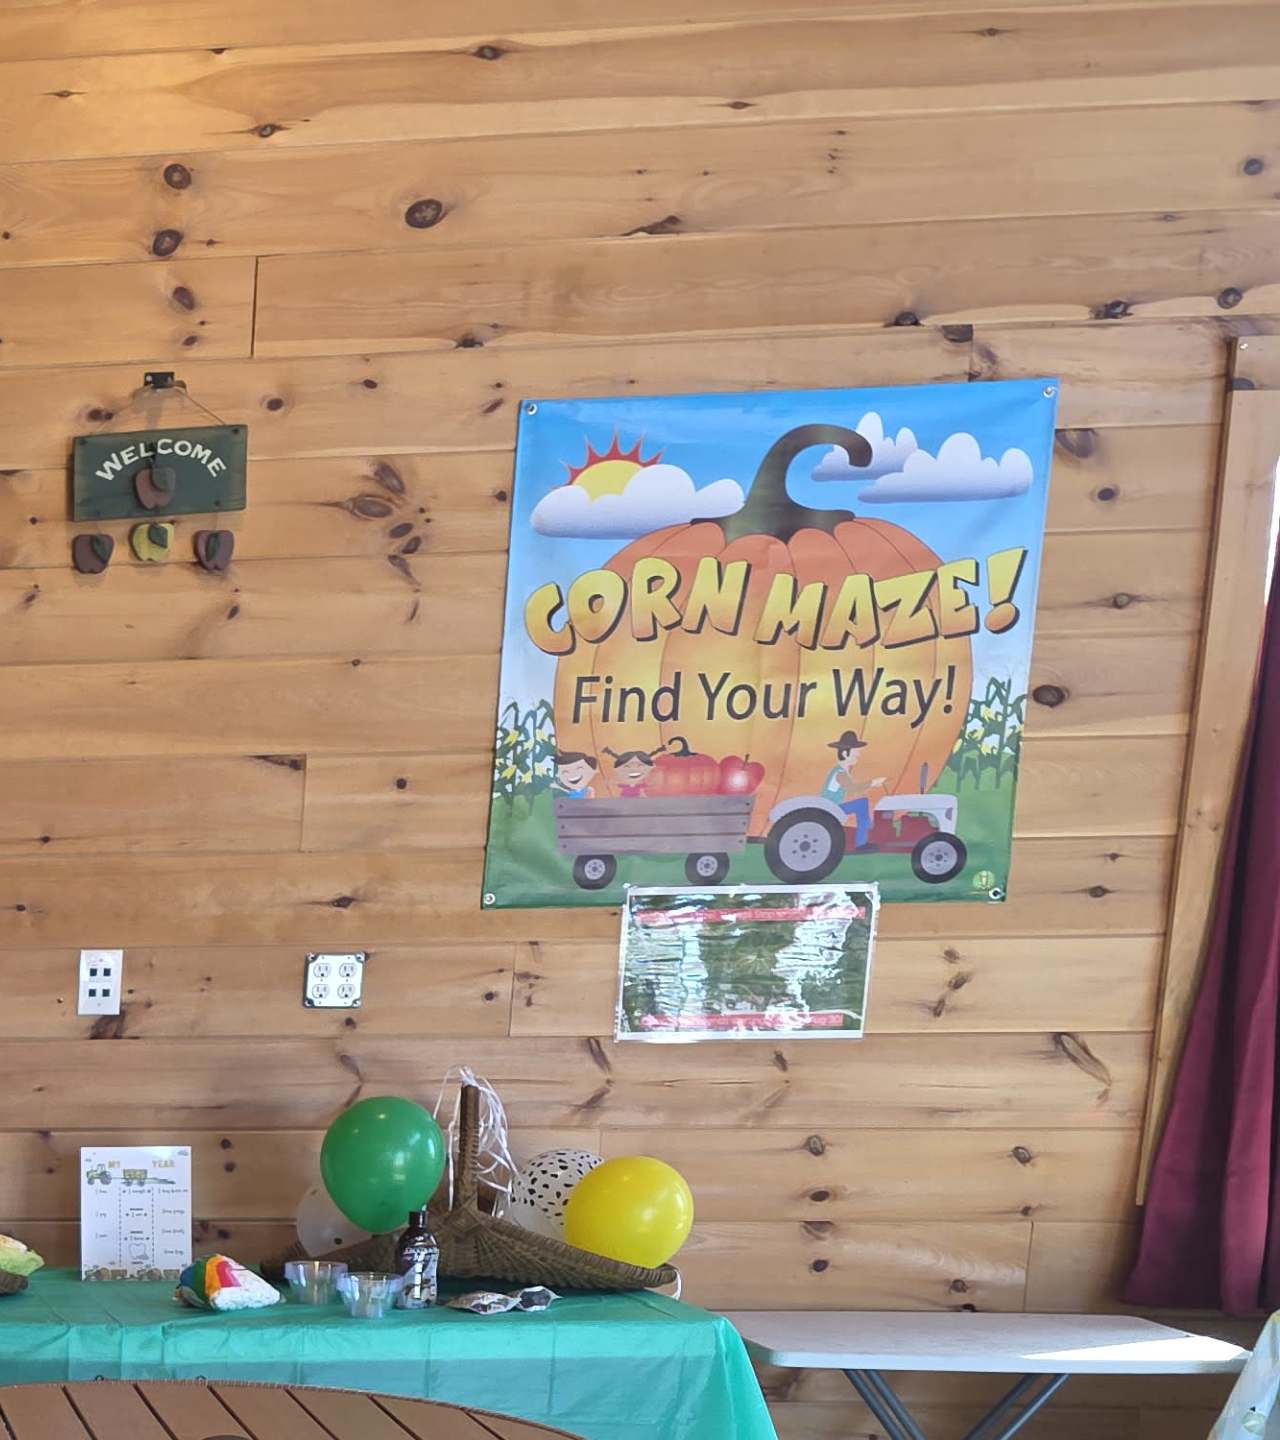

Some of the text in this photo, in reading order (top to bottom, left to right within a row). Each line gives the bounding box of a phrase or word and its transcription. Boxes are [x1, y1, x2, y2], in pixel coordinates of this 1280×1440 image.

[95, 438, 228, 482] WELCOME
[523, 545, 1029, 656] CORN MAZE!
[570, 664, 957, 732] Find Your Way!
